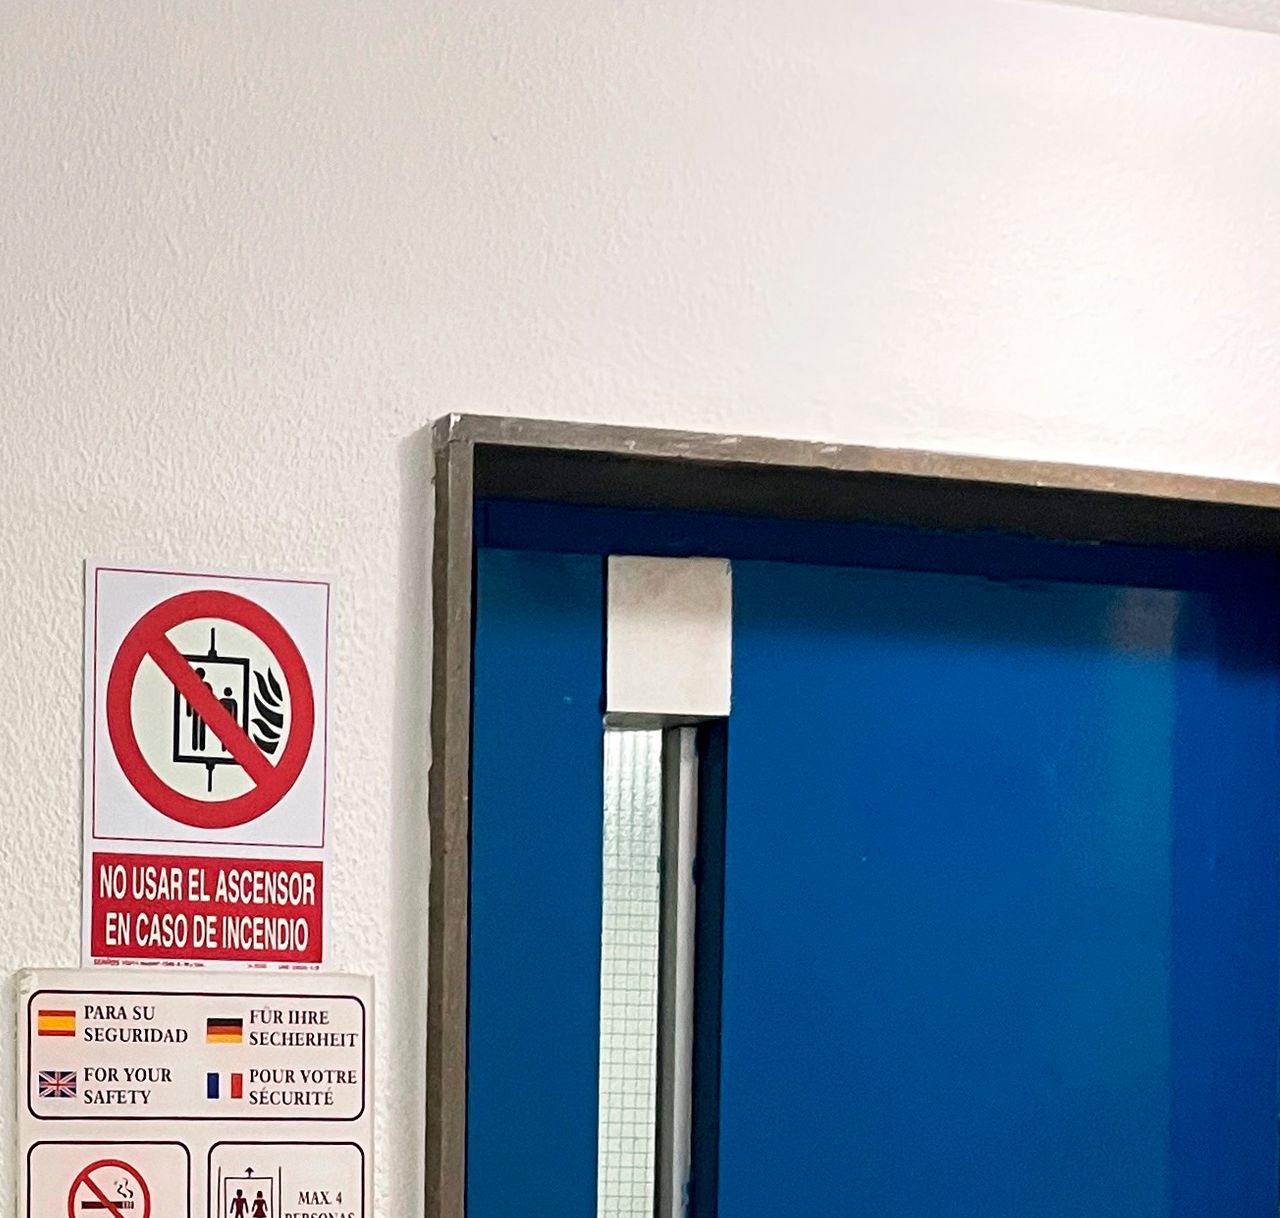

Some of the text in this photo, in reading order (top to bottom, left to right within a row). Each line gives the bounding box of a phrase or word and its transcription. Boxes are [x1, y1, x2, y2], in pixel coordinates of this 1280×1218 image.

[99, 864, 316, 905] NO USAR EL ASCENSOR
[105, 912, 309, 951] EN CASO DE INCENDIO
[84, 1005, 155, 1020] PARA SU
[249, 1005, 330, 1025] FÜR IHRE
[83, 1027, 188, 1043] SEGURIDAD
[249, 1031, 359, 1047] SECHERHEIT
[83, 1067, 172, 1082] FOR YOUR
[249, 1069, 358, 1084] POUR VOTRE
[83, 1089, 151, 1104] SAFETY
[249, 1086, 334, 1106] SÉCURITÉ
[335, 1191, 342, 1205] 4
